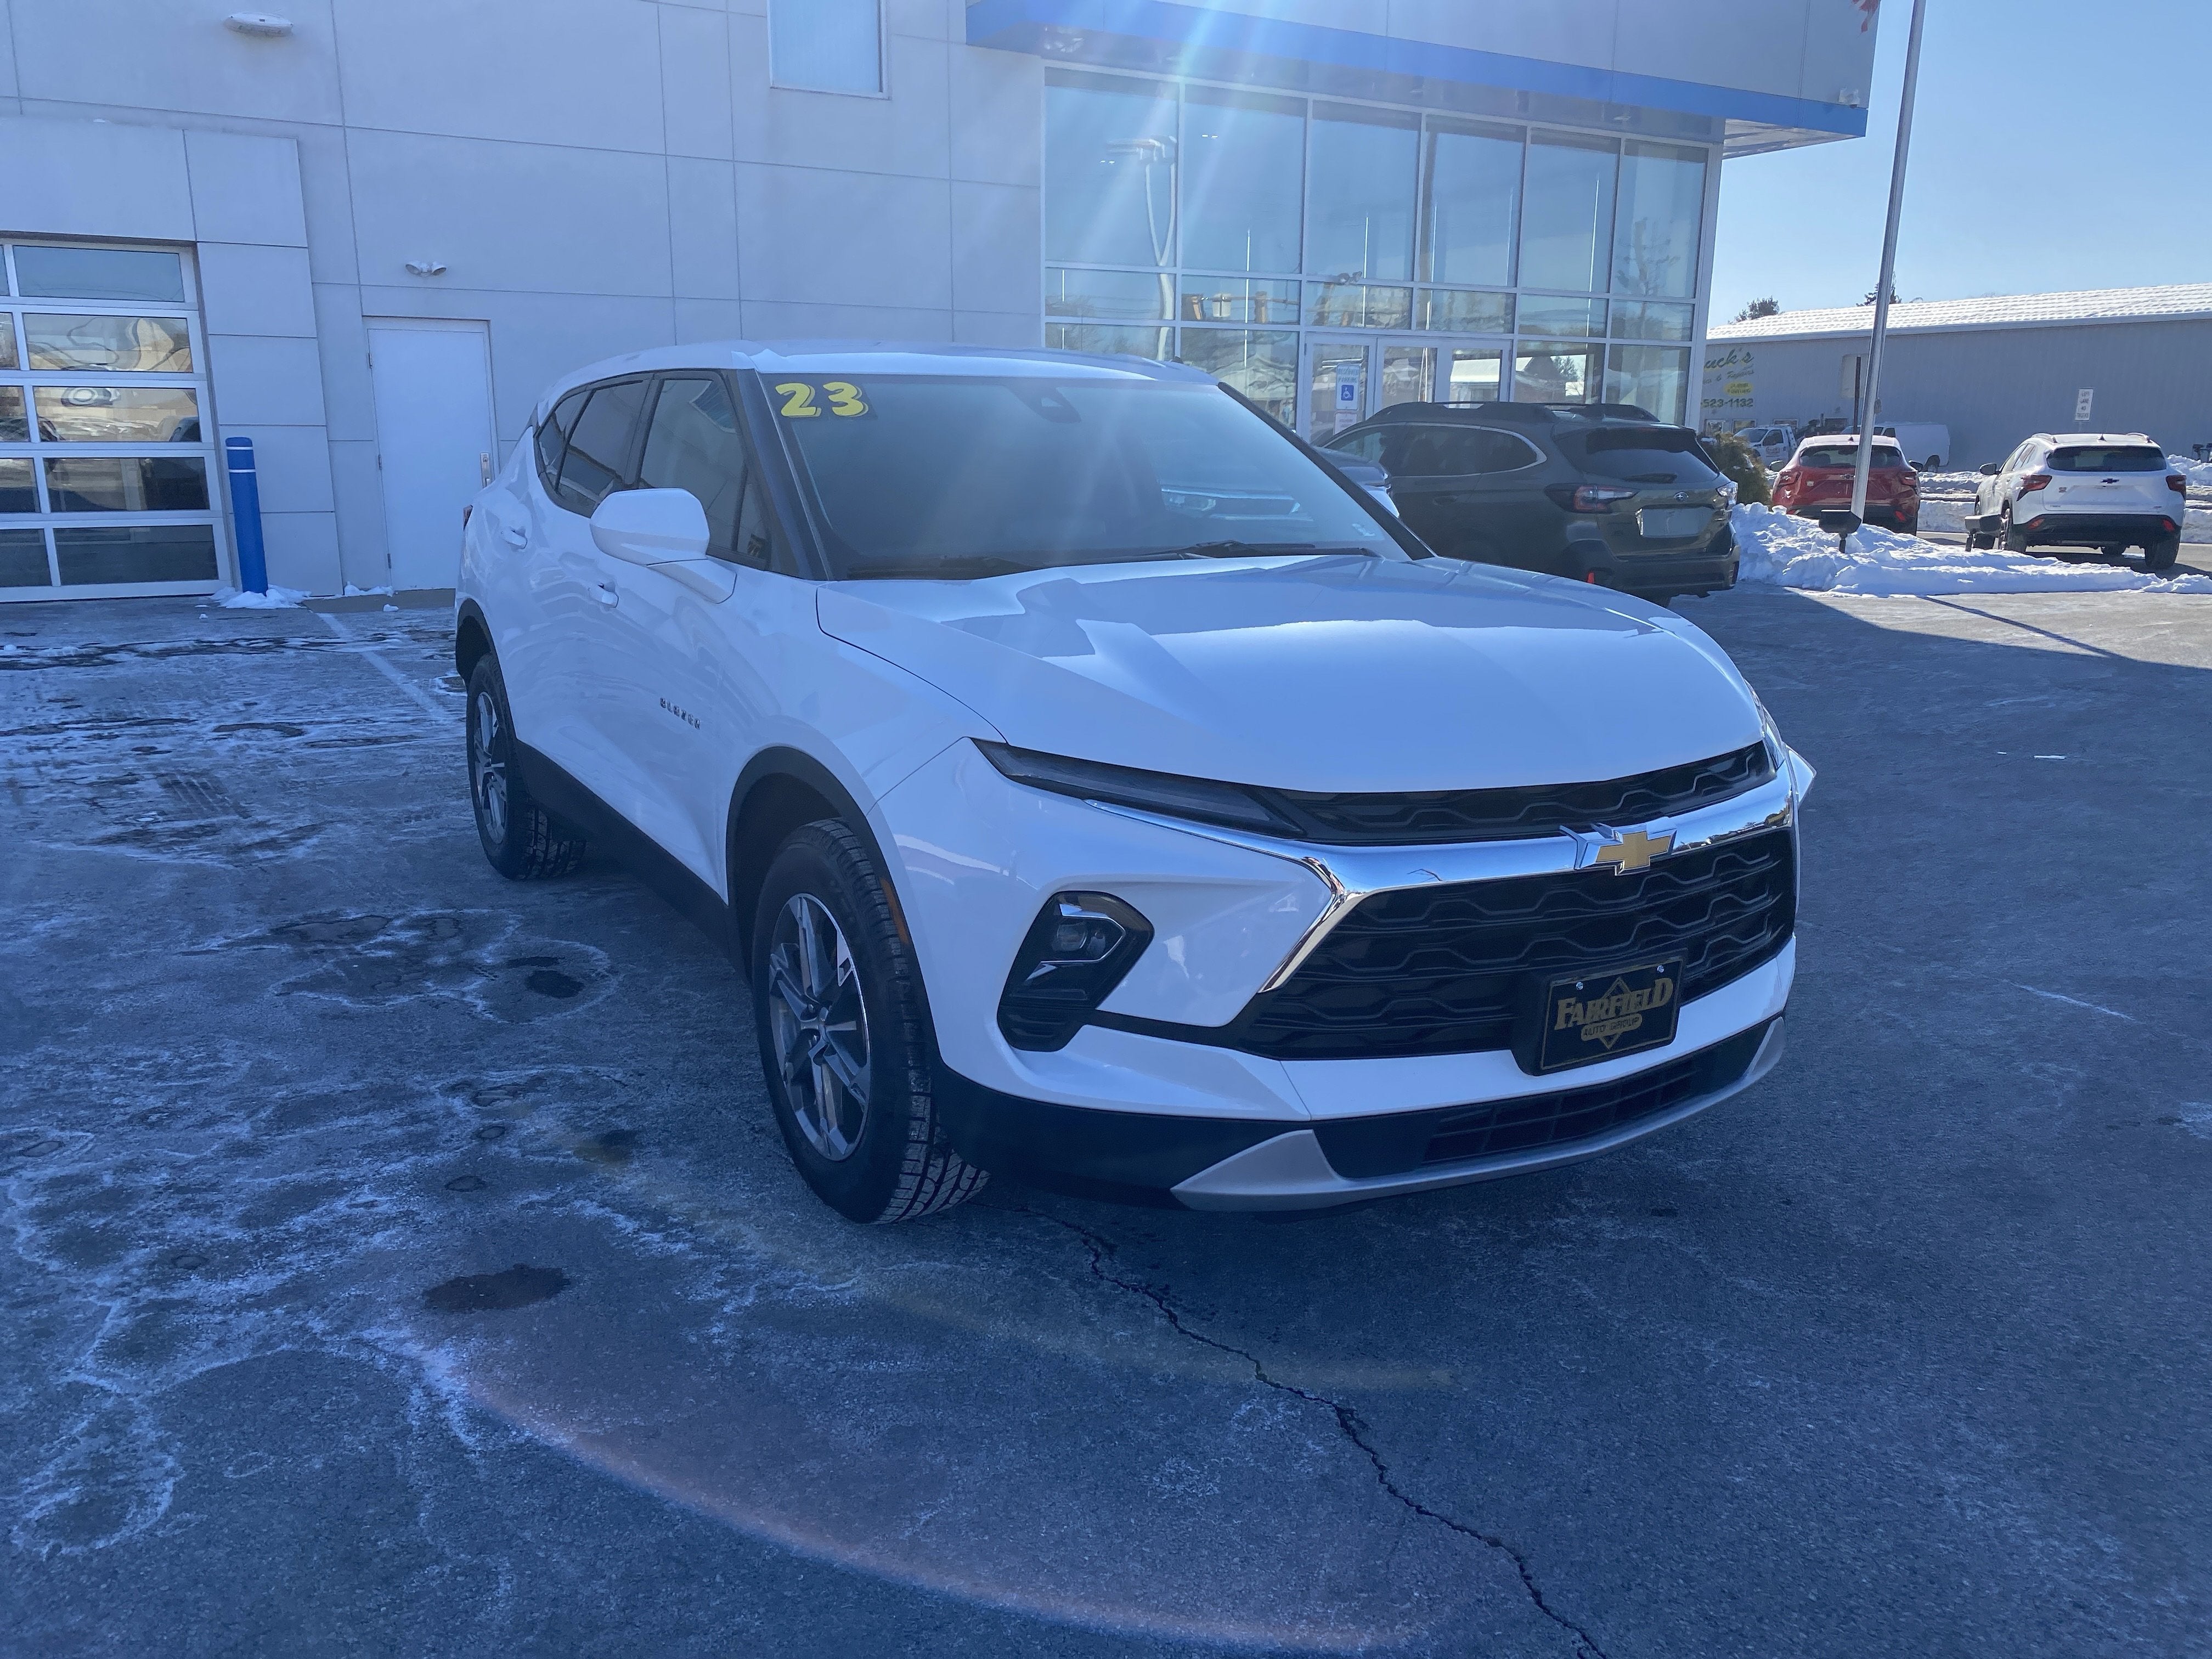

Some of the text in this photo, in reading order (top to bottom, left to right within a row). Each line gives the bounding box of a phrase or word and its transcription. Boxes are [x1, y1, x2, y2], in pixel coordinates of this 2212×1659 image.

[1703, 348, 1754, 369] uck's
[775, 381, 869, 417] 23
[659, 697, 701, 730] BLAZER
[1554, 978, 1673, 1030] FAIRFIELD
[1583, 1016, 1640, 1036] AUTO GROUP
